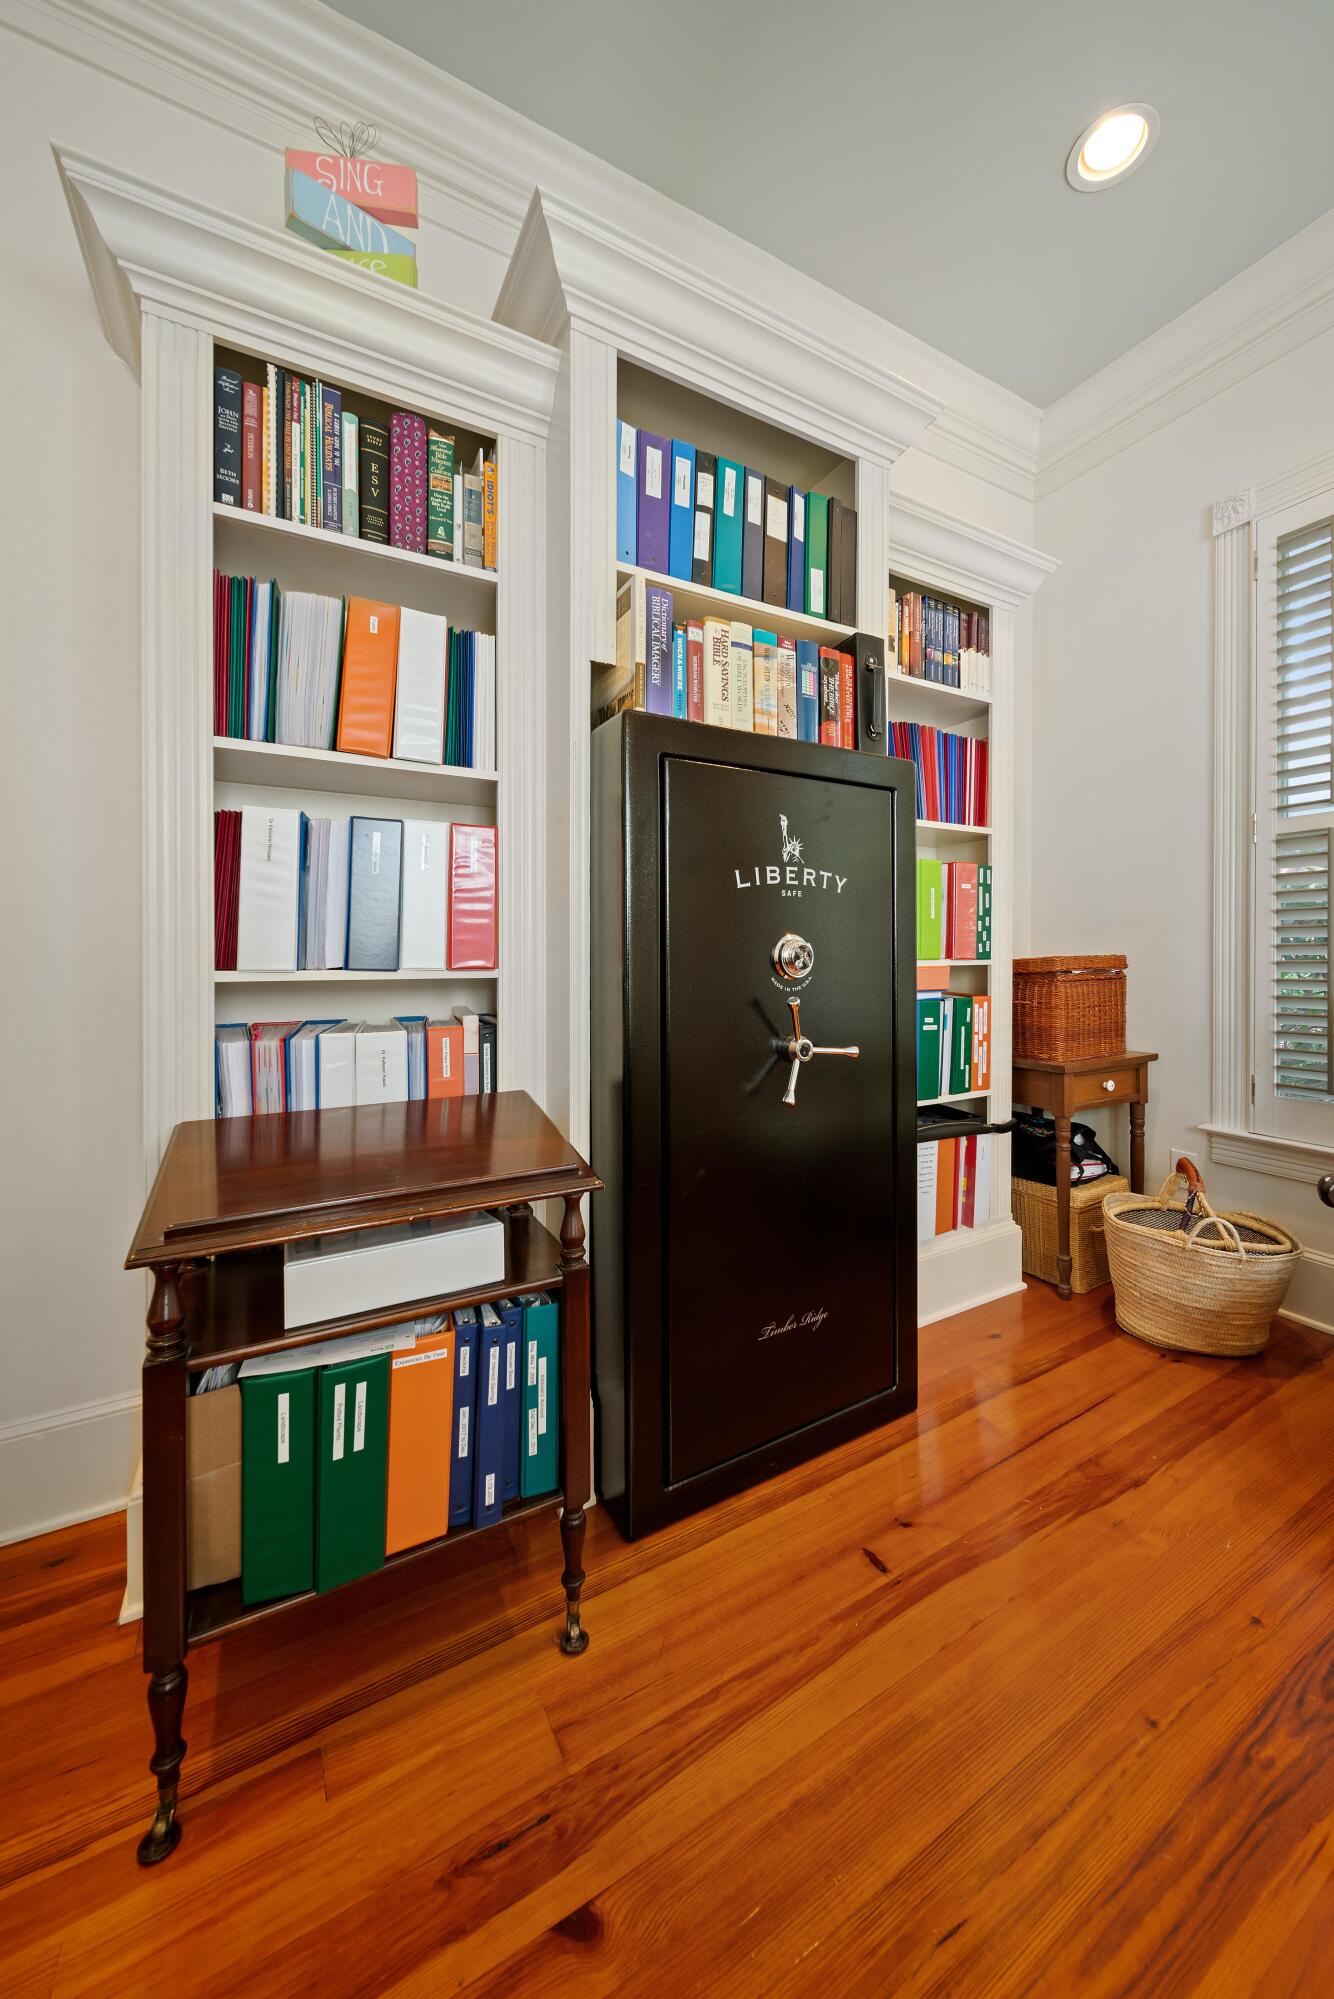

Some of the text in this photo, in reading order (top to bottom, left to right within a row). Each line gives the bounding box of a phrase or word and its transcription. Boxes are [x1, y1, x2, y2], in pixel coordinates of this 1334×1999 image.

[316, 156, 383, 196] SING
[322, 194, 389, 254] AND
[219, 406, 239, 418] JOHN
[324, 402, 334, 472] BIBLICAL HOLIDAYS
[217, 473, 240, 485] MOORE
[220, 467, 236, 477] BETH
[660, 597, 669, 653] Dictionary of
[651, 596, 661, 686] BIBLICAL IMAGERY
[712, 636, 721, 666] BIBLE
[721, 629, 730, 658] HARD
[721, 660, 730, 702] SAYINGS
[735, 866, 848, 893] LIBERTY
[781, 889, 802, 897] SAFE
[771, 976, 784, 990] MADE
[758, 1314, 797, 1340] Timber
